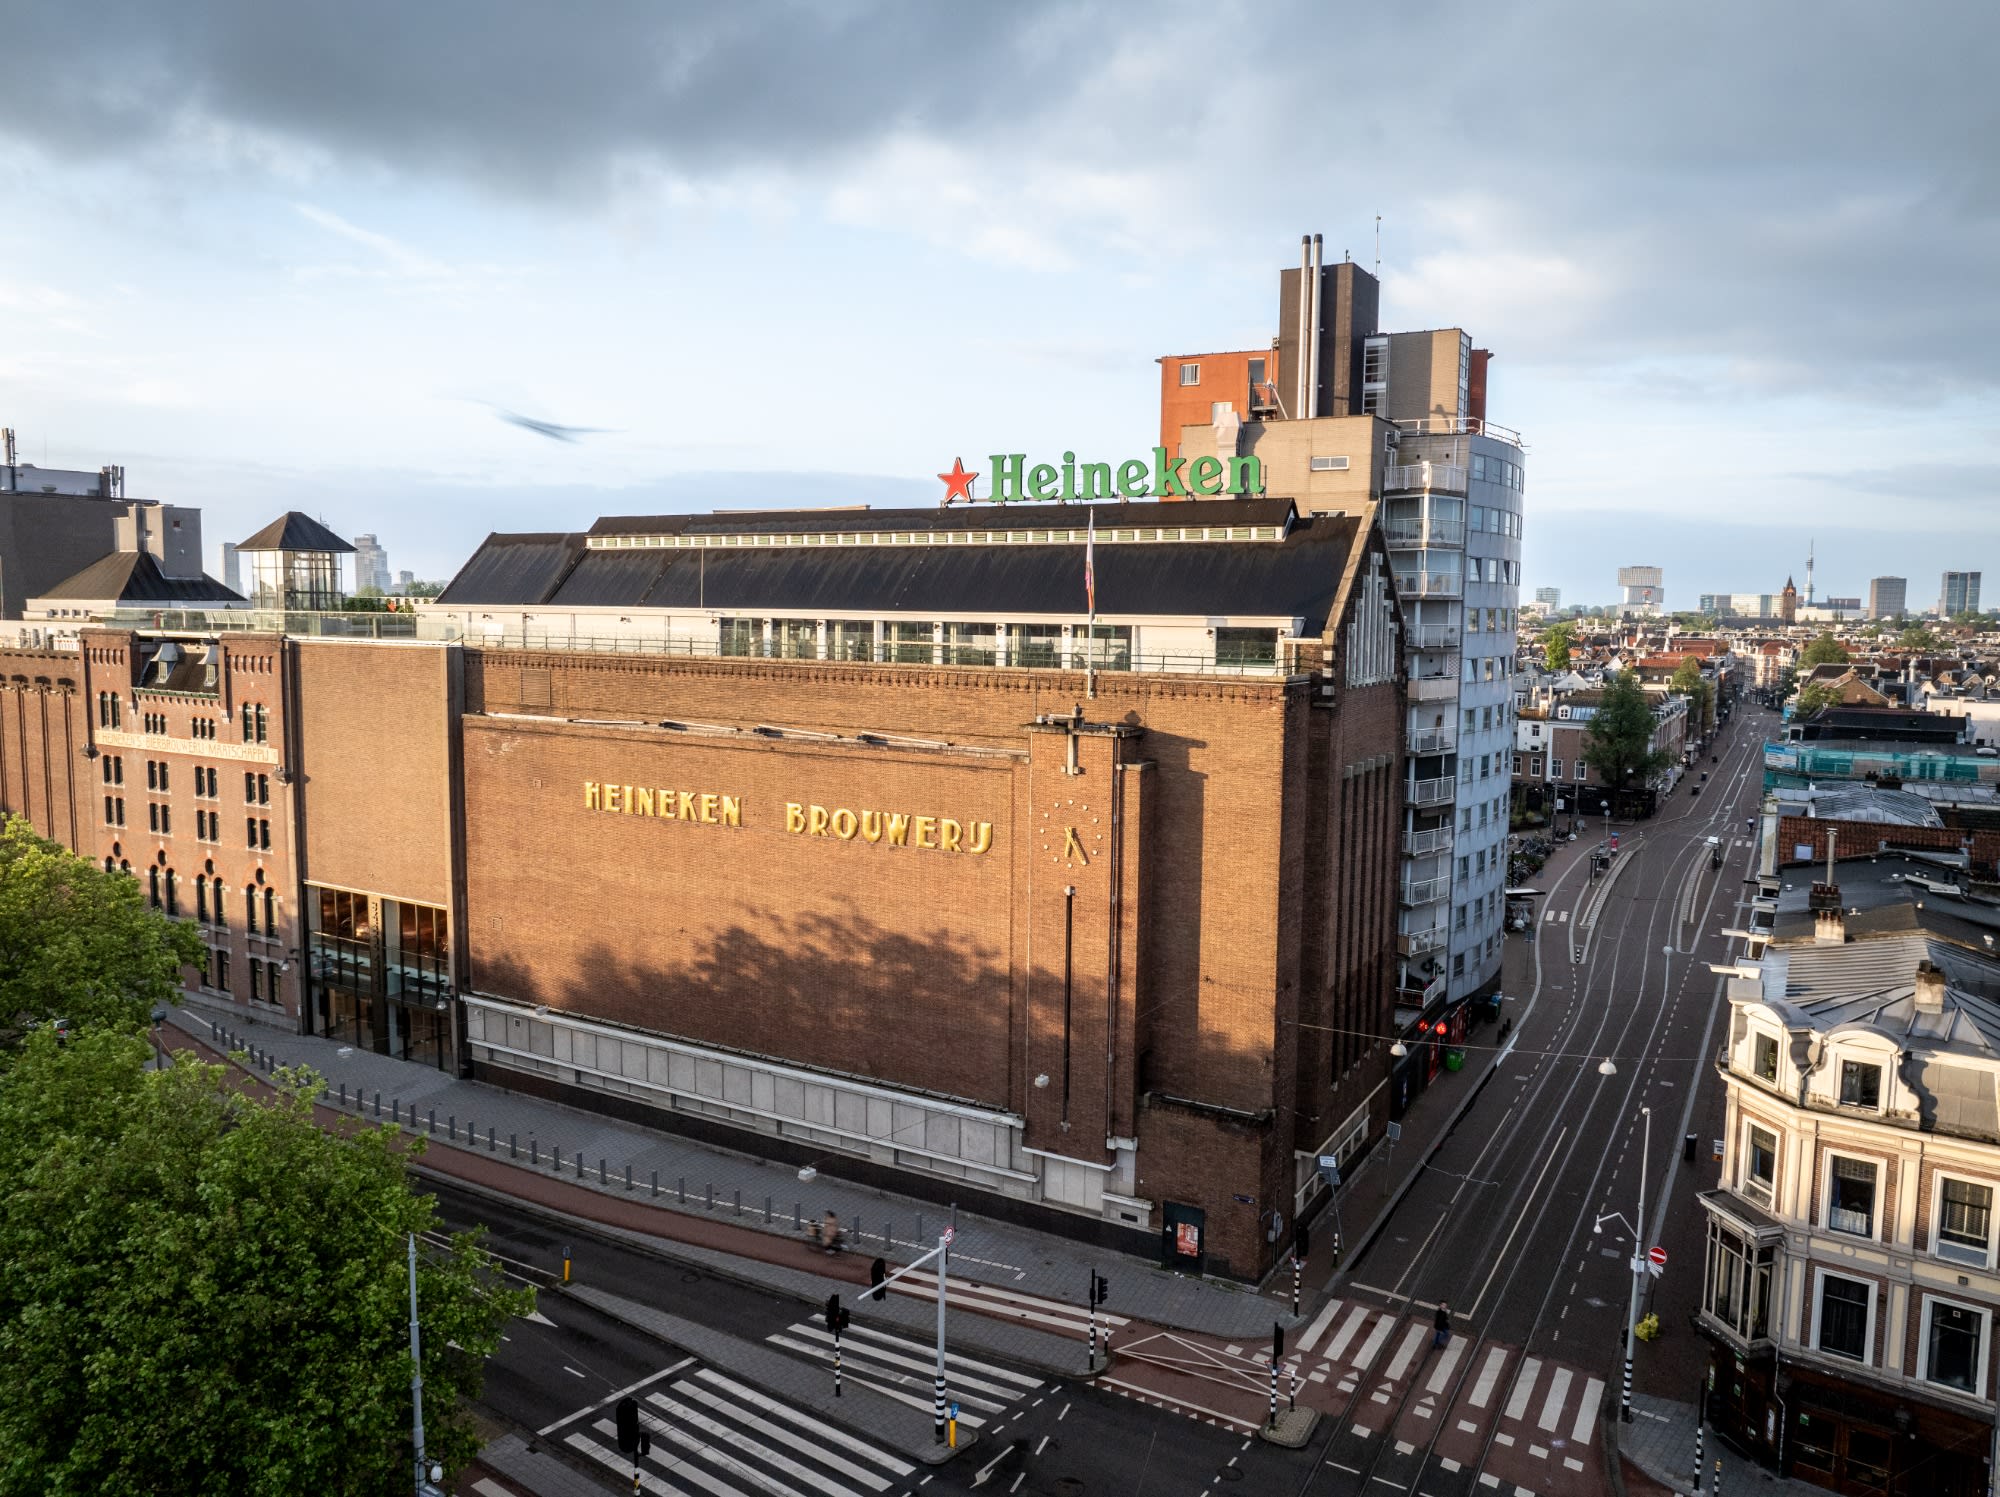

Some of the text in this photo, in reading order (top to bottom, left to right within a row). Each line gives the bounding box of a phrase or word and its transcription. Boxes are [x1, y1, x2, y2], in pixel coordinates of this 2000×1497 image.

[988, 447, 1266, 501] Heineken
[584, 781, 993, 855] HEINEKEN BROUWERIJ
